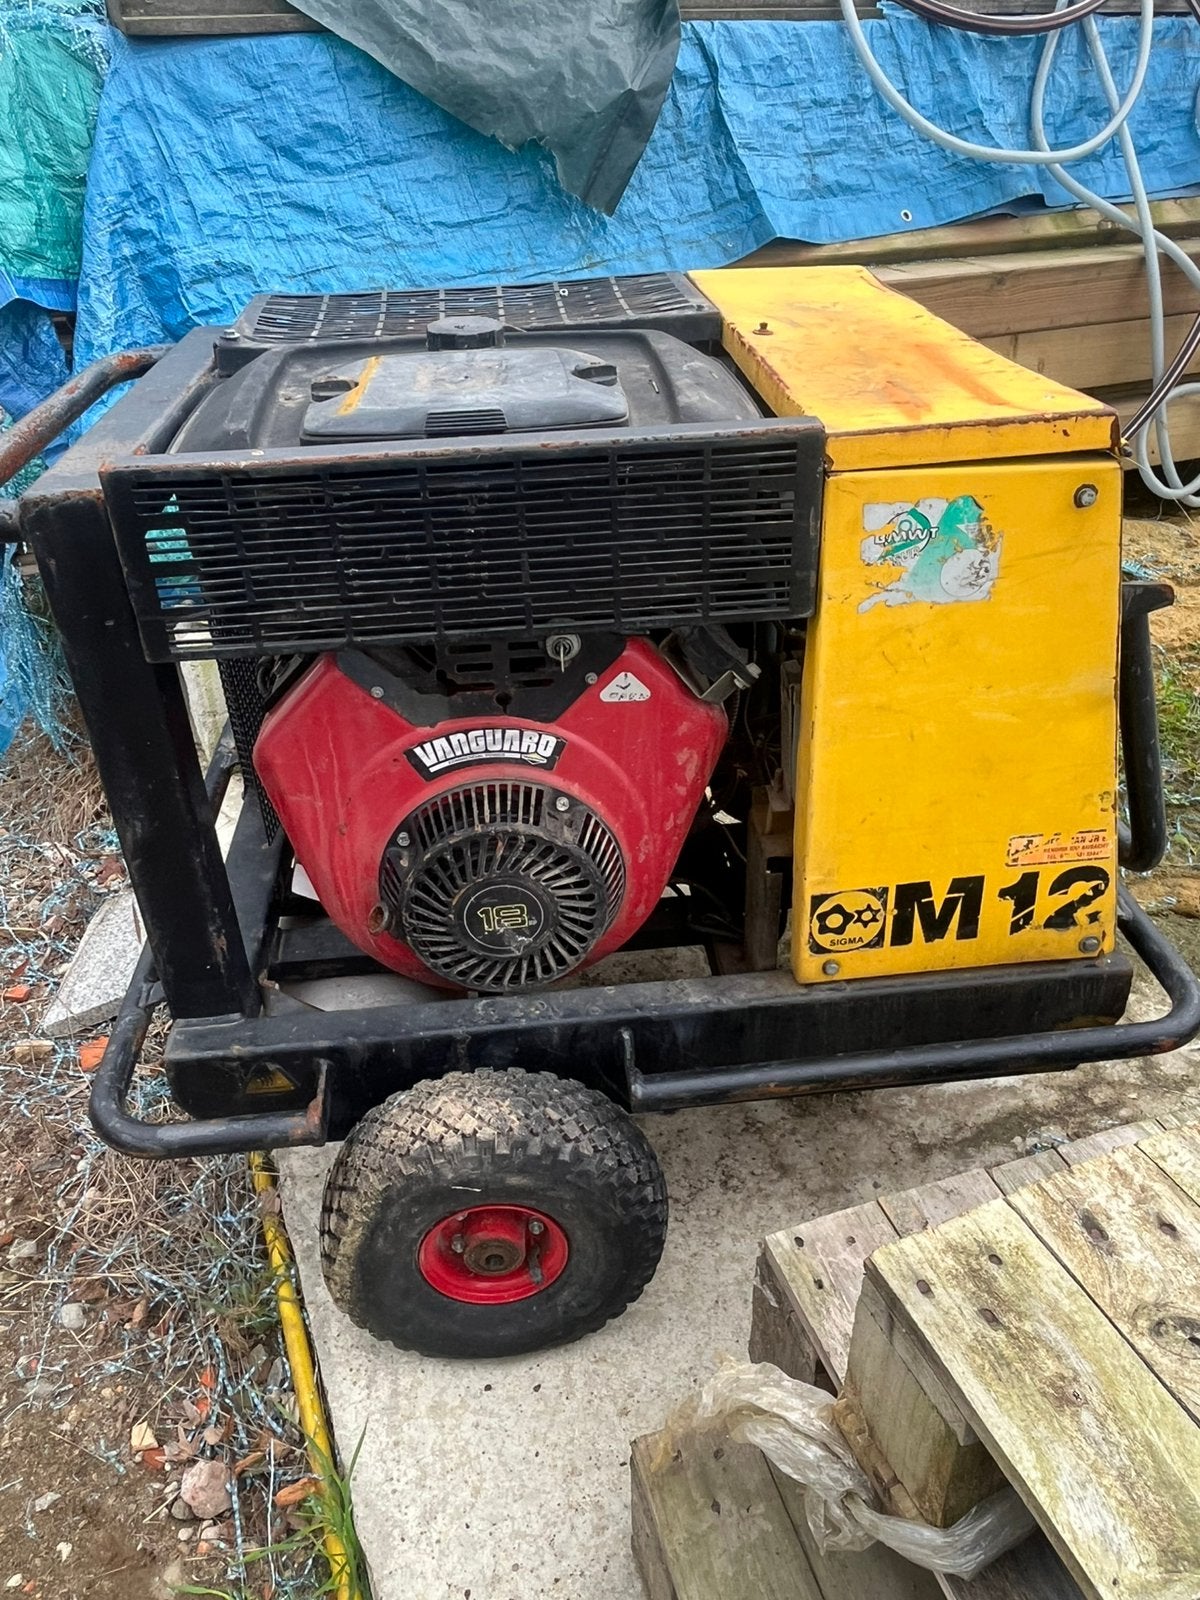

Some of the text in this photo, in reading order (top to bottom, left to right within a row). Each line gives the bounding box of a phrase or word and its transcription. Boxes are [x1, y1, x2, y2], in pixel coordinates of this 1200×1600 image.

[413, 728, 557, 767] VANGUARD
[477, 903, 528, 932] 18
[890, 865, 1111, 947] M 12
[829, 936, 865, 947] SIGMA
